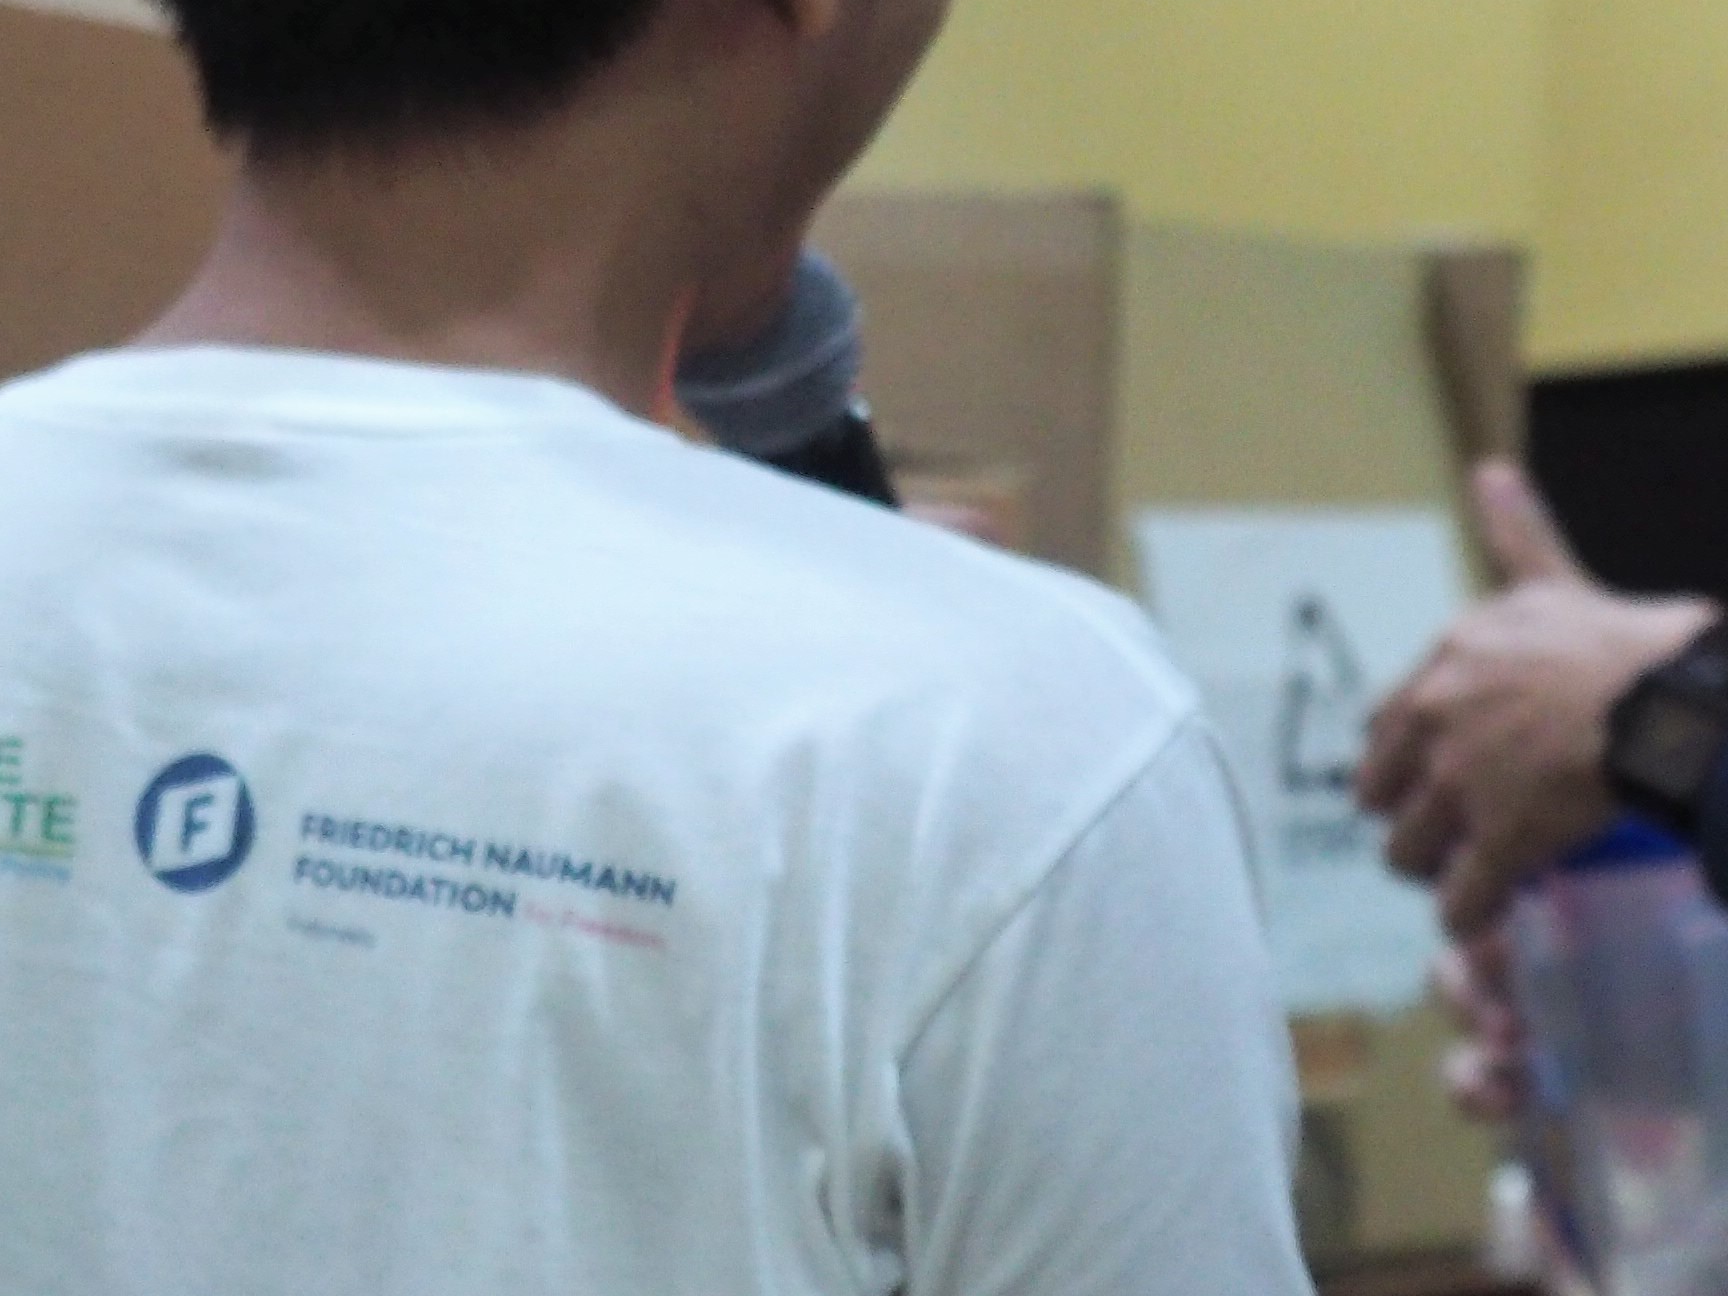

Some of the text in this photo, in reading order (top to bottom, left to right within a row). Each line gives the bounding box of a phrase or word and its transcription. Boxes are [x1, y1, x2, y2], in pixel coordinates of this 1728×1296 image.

[181, 793, 215, 852] F
[292, 855, 519, 920] FOUNDATION
[300, 813, 679, 907] FRIEDRICH NAUMANN
